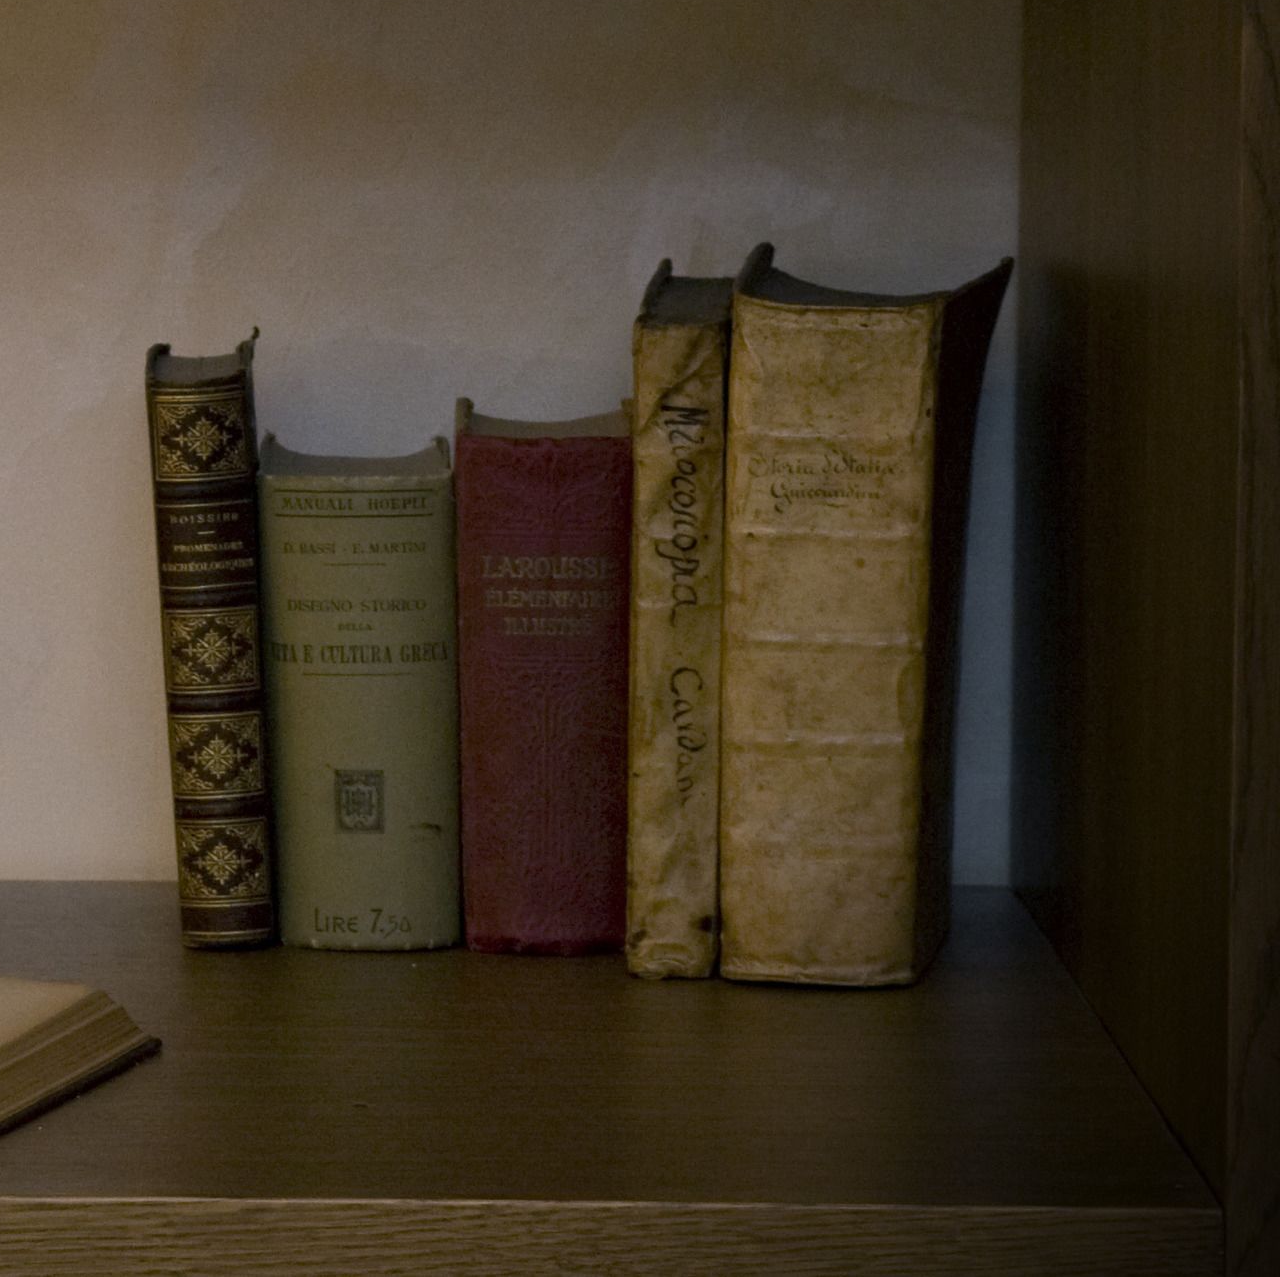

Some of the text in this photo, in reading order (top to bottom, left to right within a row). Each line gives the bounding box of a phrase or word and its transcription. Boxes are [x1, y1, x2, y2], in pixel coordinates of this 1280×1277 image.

[281, 496, 428, 512] MANUALI HOEPLI
[480, 555, 615, 579] LAROUSSE
[286, 598, 428, 612] DISEGNO STORICO
[303, 644, 313, 664] E
[320, 644, 393, 664] CULTURA
[400, 642, 449, 664] GRECA
[314, 906, 359, 933] LIRE
